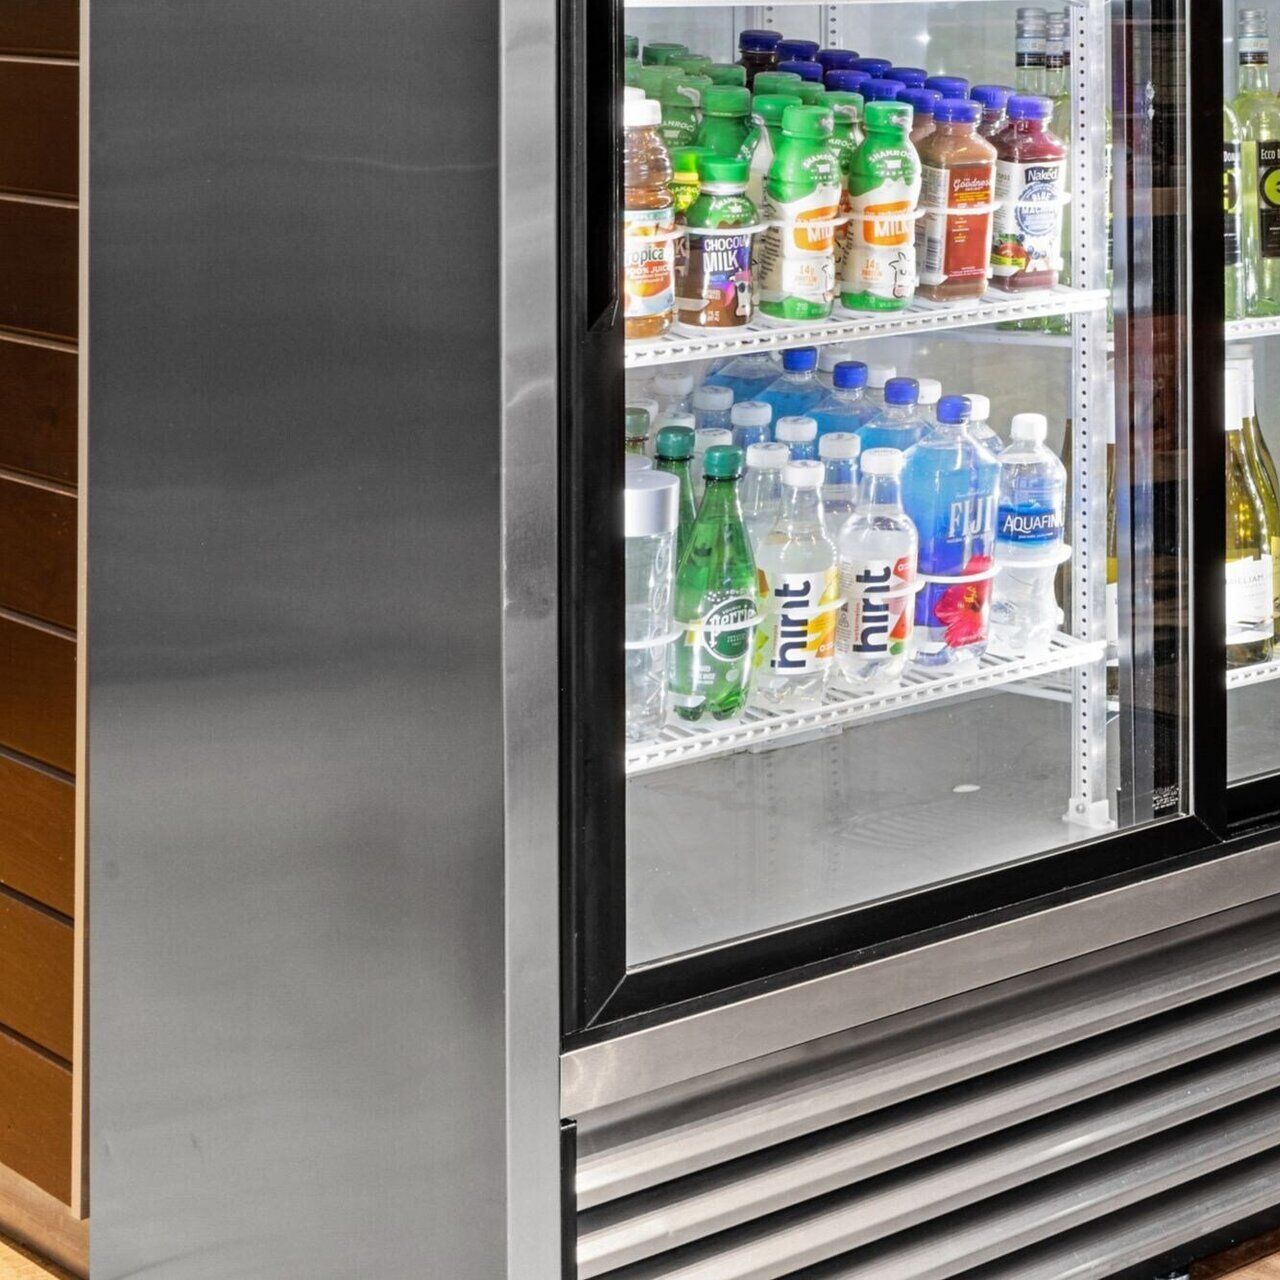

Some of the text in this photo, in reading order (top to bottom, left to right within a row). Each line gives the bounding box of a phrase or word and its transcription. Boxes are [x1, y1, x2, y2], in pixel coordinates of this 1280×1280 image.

[703, 252, 738, 272] MILK
[771, 580, 811, 670] hint
[853, 566, 892, 653] hint
